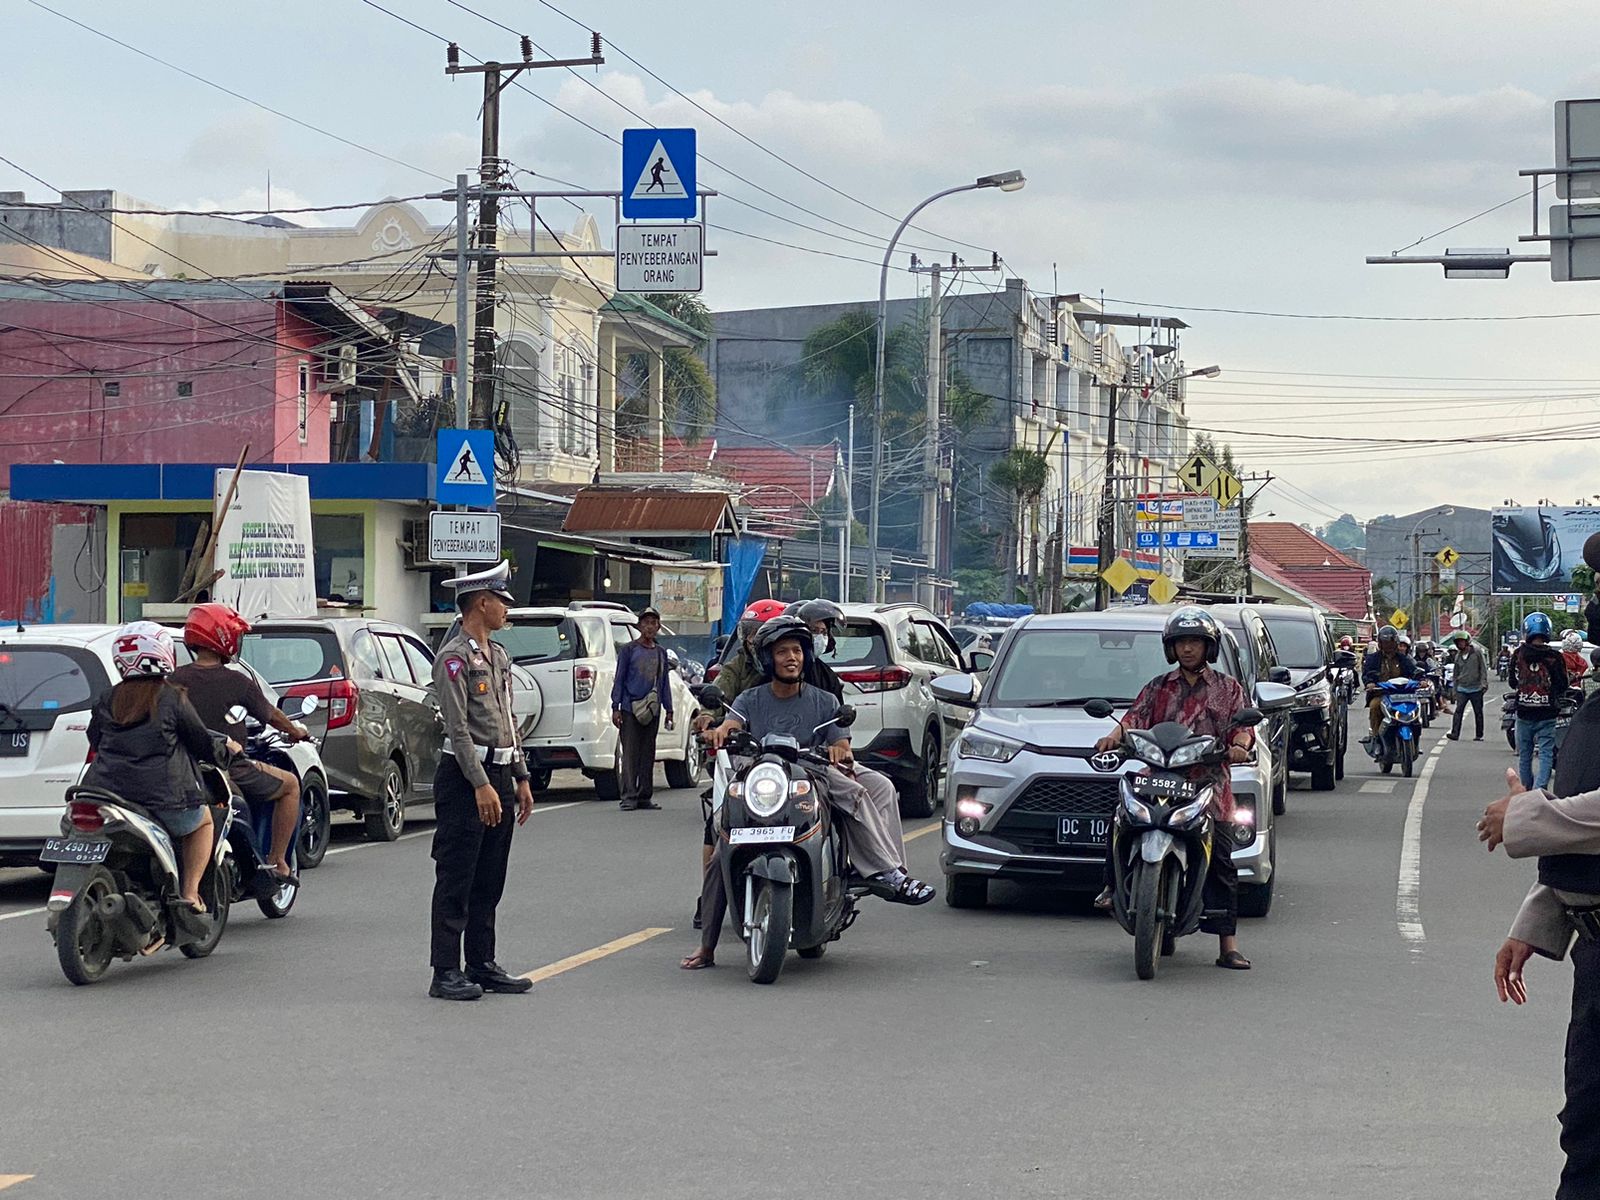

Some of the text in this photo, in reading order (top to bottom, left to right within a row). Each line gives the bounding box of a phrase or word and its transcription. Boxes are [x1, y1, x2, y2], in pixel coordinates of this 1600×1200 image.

[641, 233, 677, 247] TEMPAT
[620, 252, 698, 266] PENYEBERANGAN
[643, 269, 675, 283] ORANG
[450, 521, 480, 534] TEMPAT
[433, 538, 496, 553] PENYEBERANGAN ORANG
[11, 733, 28, 748] US
[1135, 776, 1194, 791] DC 5582 AL
[750, 828, 774, 836] 3965
[1062, 818, 1079, 835] DC
[46, 841, 108, 852] DC 4901 AY
